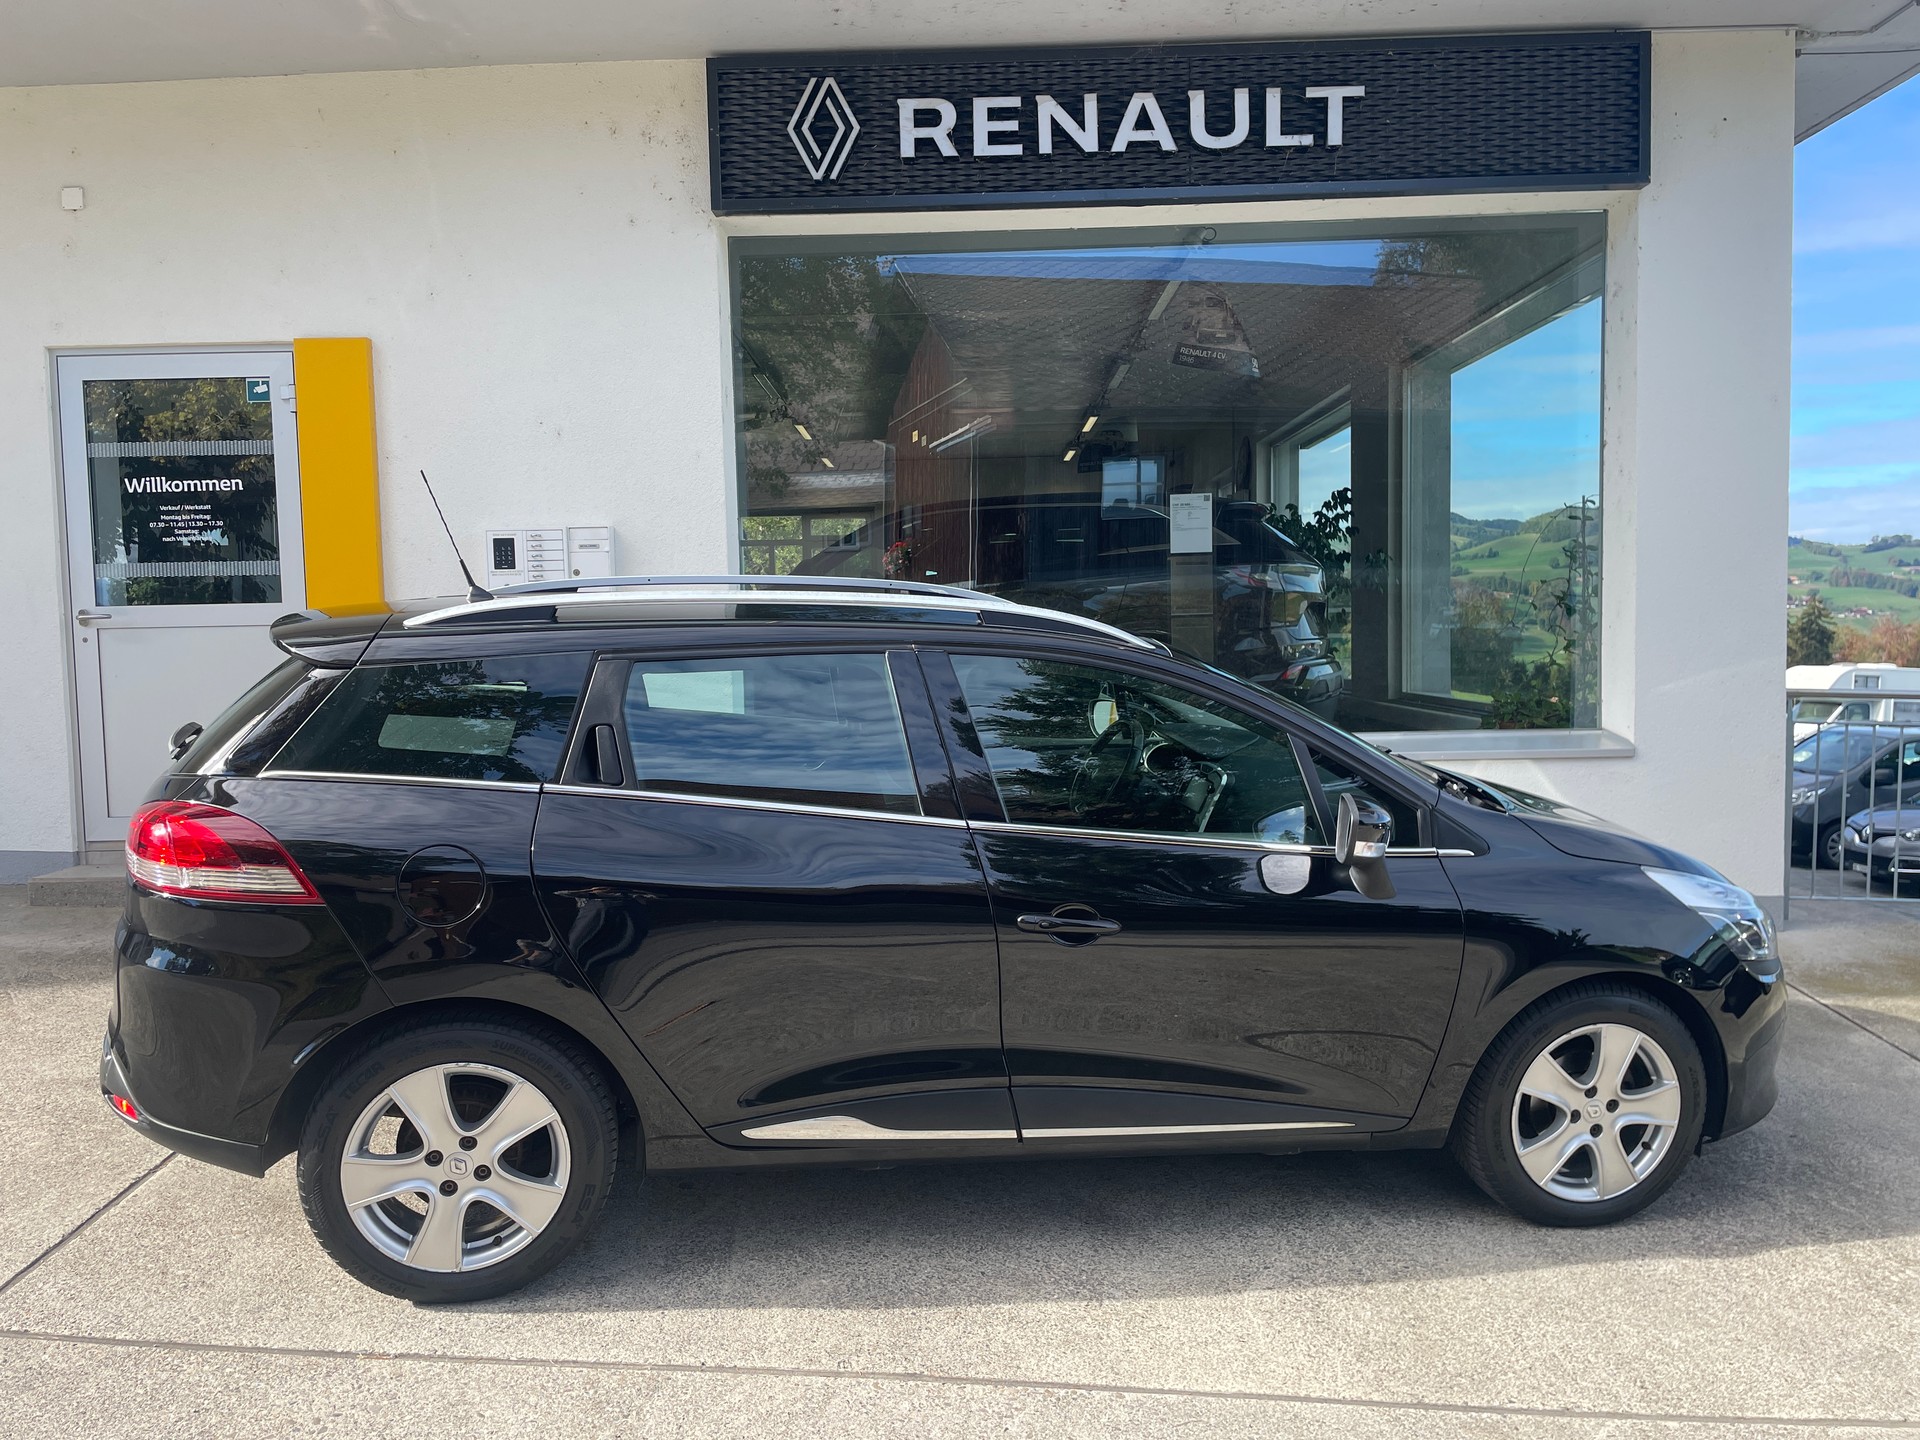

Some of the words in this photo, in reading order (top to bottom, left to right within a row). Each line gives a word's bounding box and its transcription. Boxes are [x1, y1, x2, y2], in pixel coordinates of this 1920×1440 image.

[897, 85, 1366, 159] RENAULT
[1179, 354, 1195, 363] 1946
[1180, 347, 1212, 358] RENAULT
[124, 476, 244, 494] Willkommen
[492, 1039, 554, 1071] SUPERGRIP
[553, 1071, 572, 1090] PRO
